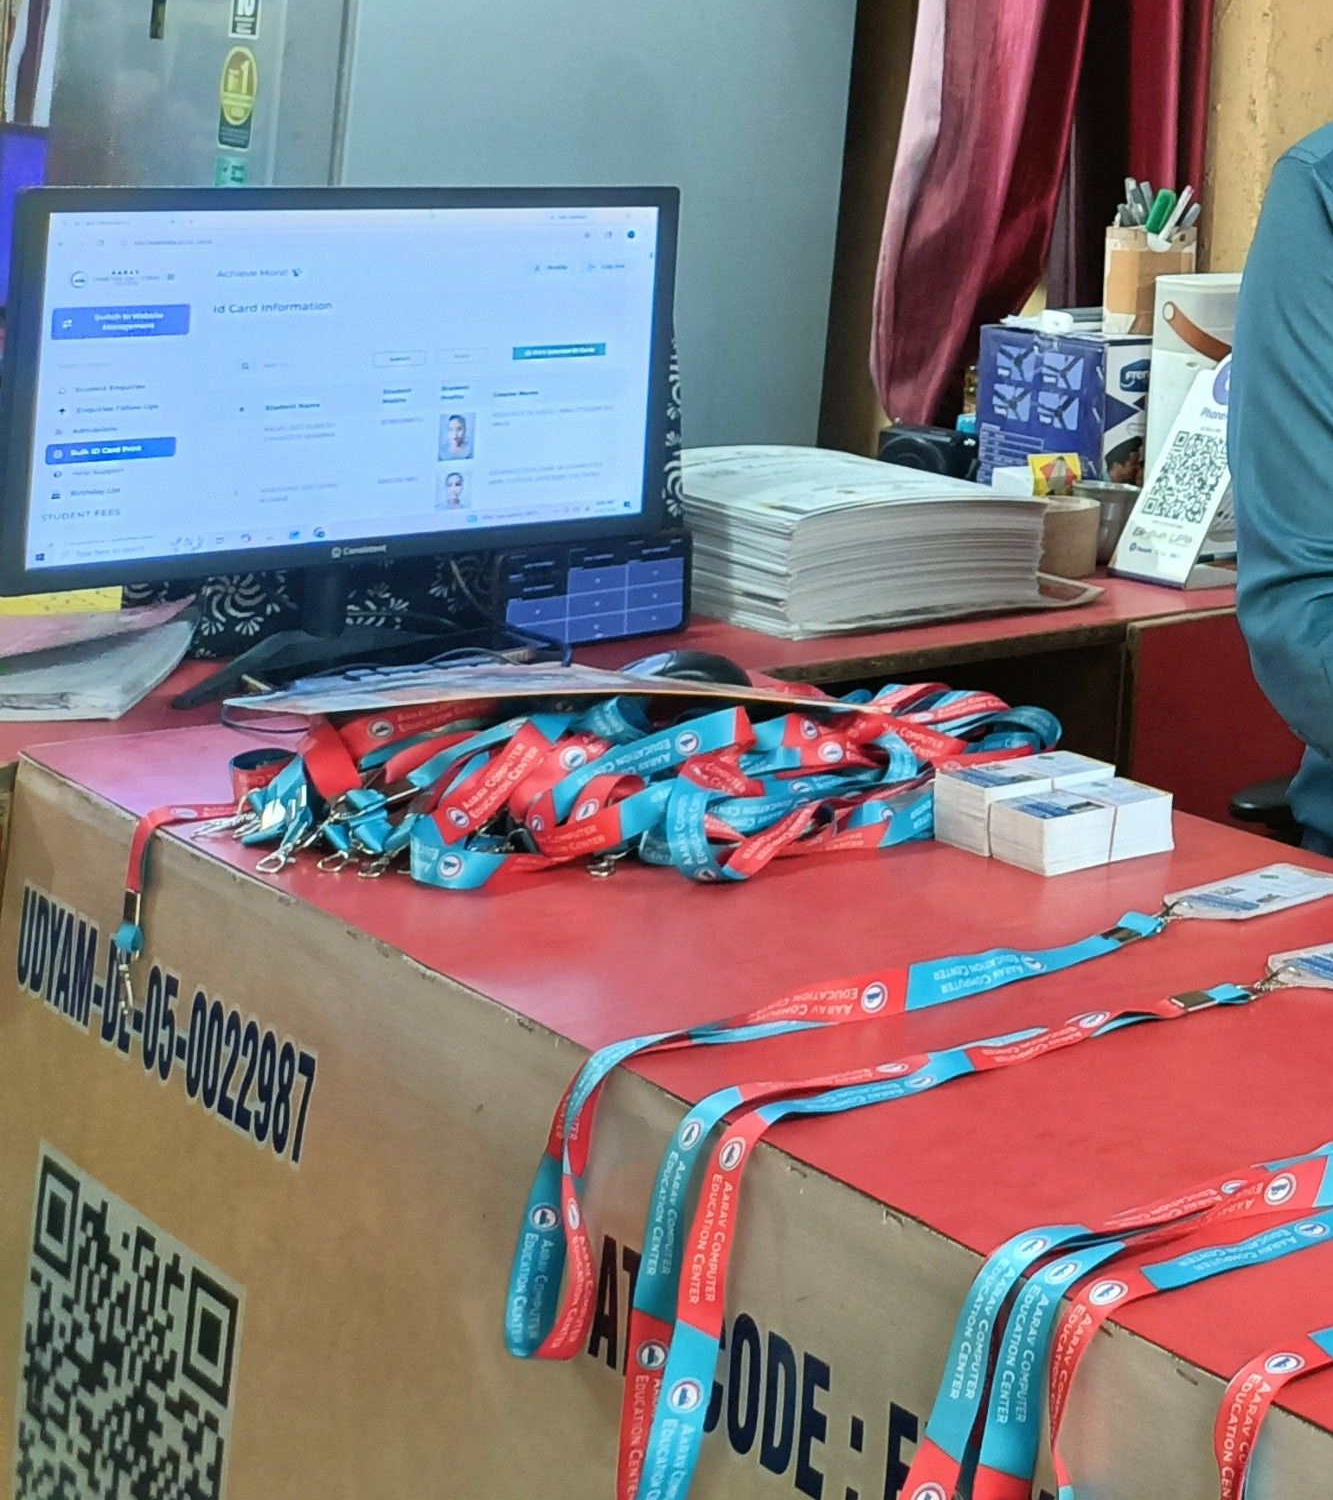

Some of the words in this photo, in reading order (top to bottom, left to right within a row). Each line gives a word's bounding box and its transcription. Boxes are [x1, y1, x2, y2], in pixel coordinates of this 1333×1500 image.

[696, 1173, 724, 1255] EDUCATION
[714, 1181, 735, 1228] AARAV
[687, 1255, 706, 1306] CENTER
[704, 1229, 726, 1303] COMPUTER
[963, 1257, 1008, 1339] EDUCATION
[1006, 1283, 1041, 1368] EDUCATION
[1025, 1292, 1050, 1345] AARAV
[949, 1340, 973, 1401] CENTER
[964, 1318, 989, 1401] COMPUTER
[995, 1368, 1016, 1425] CENTER
[1015, 1350, 1036, 1424] COMPUTER
[1222, 1372, 1263, 1463] EDUCATION
